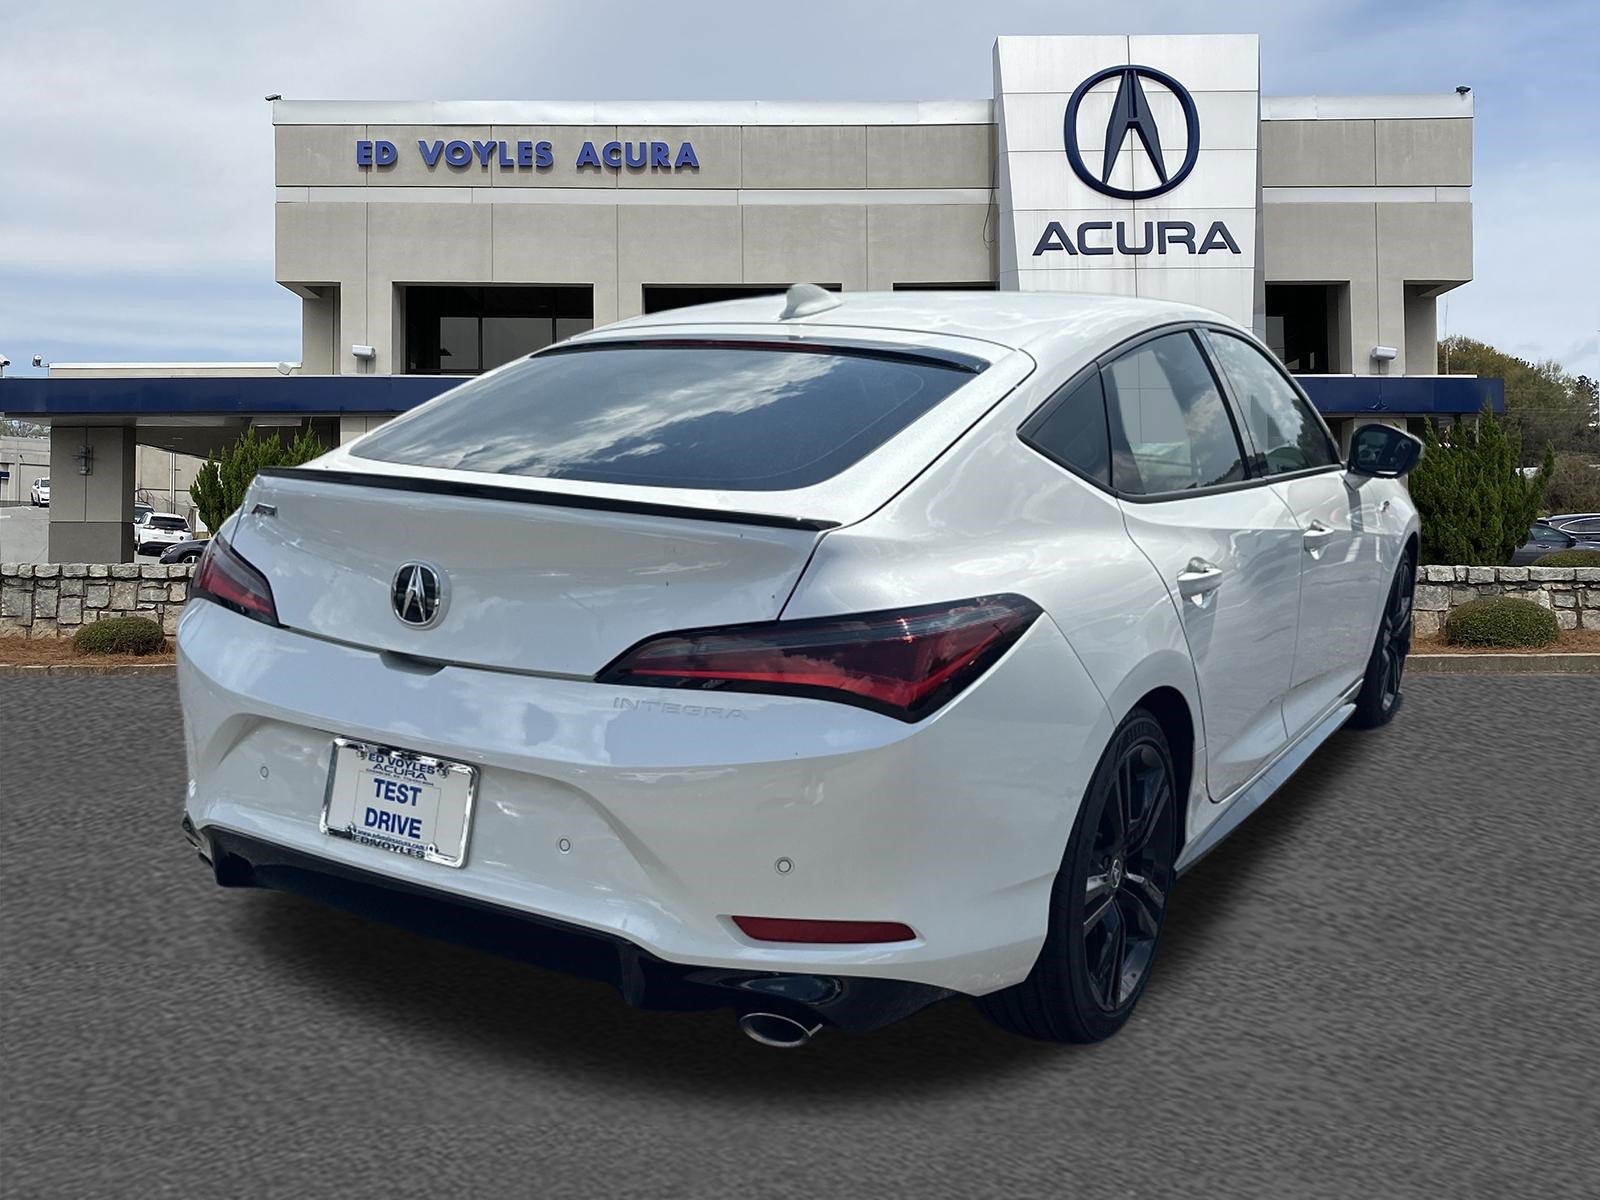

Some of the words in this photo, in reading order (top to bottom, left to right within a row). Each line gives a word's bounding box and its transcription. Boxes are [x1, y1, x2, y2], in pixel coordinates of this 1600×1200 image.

[356, 140, 397, 168] ED
[418, 140, 554, 168] VOYLES
[576, 141, 700, 168] ACURA
[1032, 221, 1242, 256] ACURA
[613, 697, 748, 720] INTEGRA
[368, 752, 385, 763] ED
[388, 756, 435, 775] VOYLES
[373, 763, 427, 781] ACURA
[374, 778, 422, 806] TEST
[364, 807, 422, 839] DRIVE
